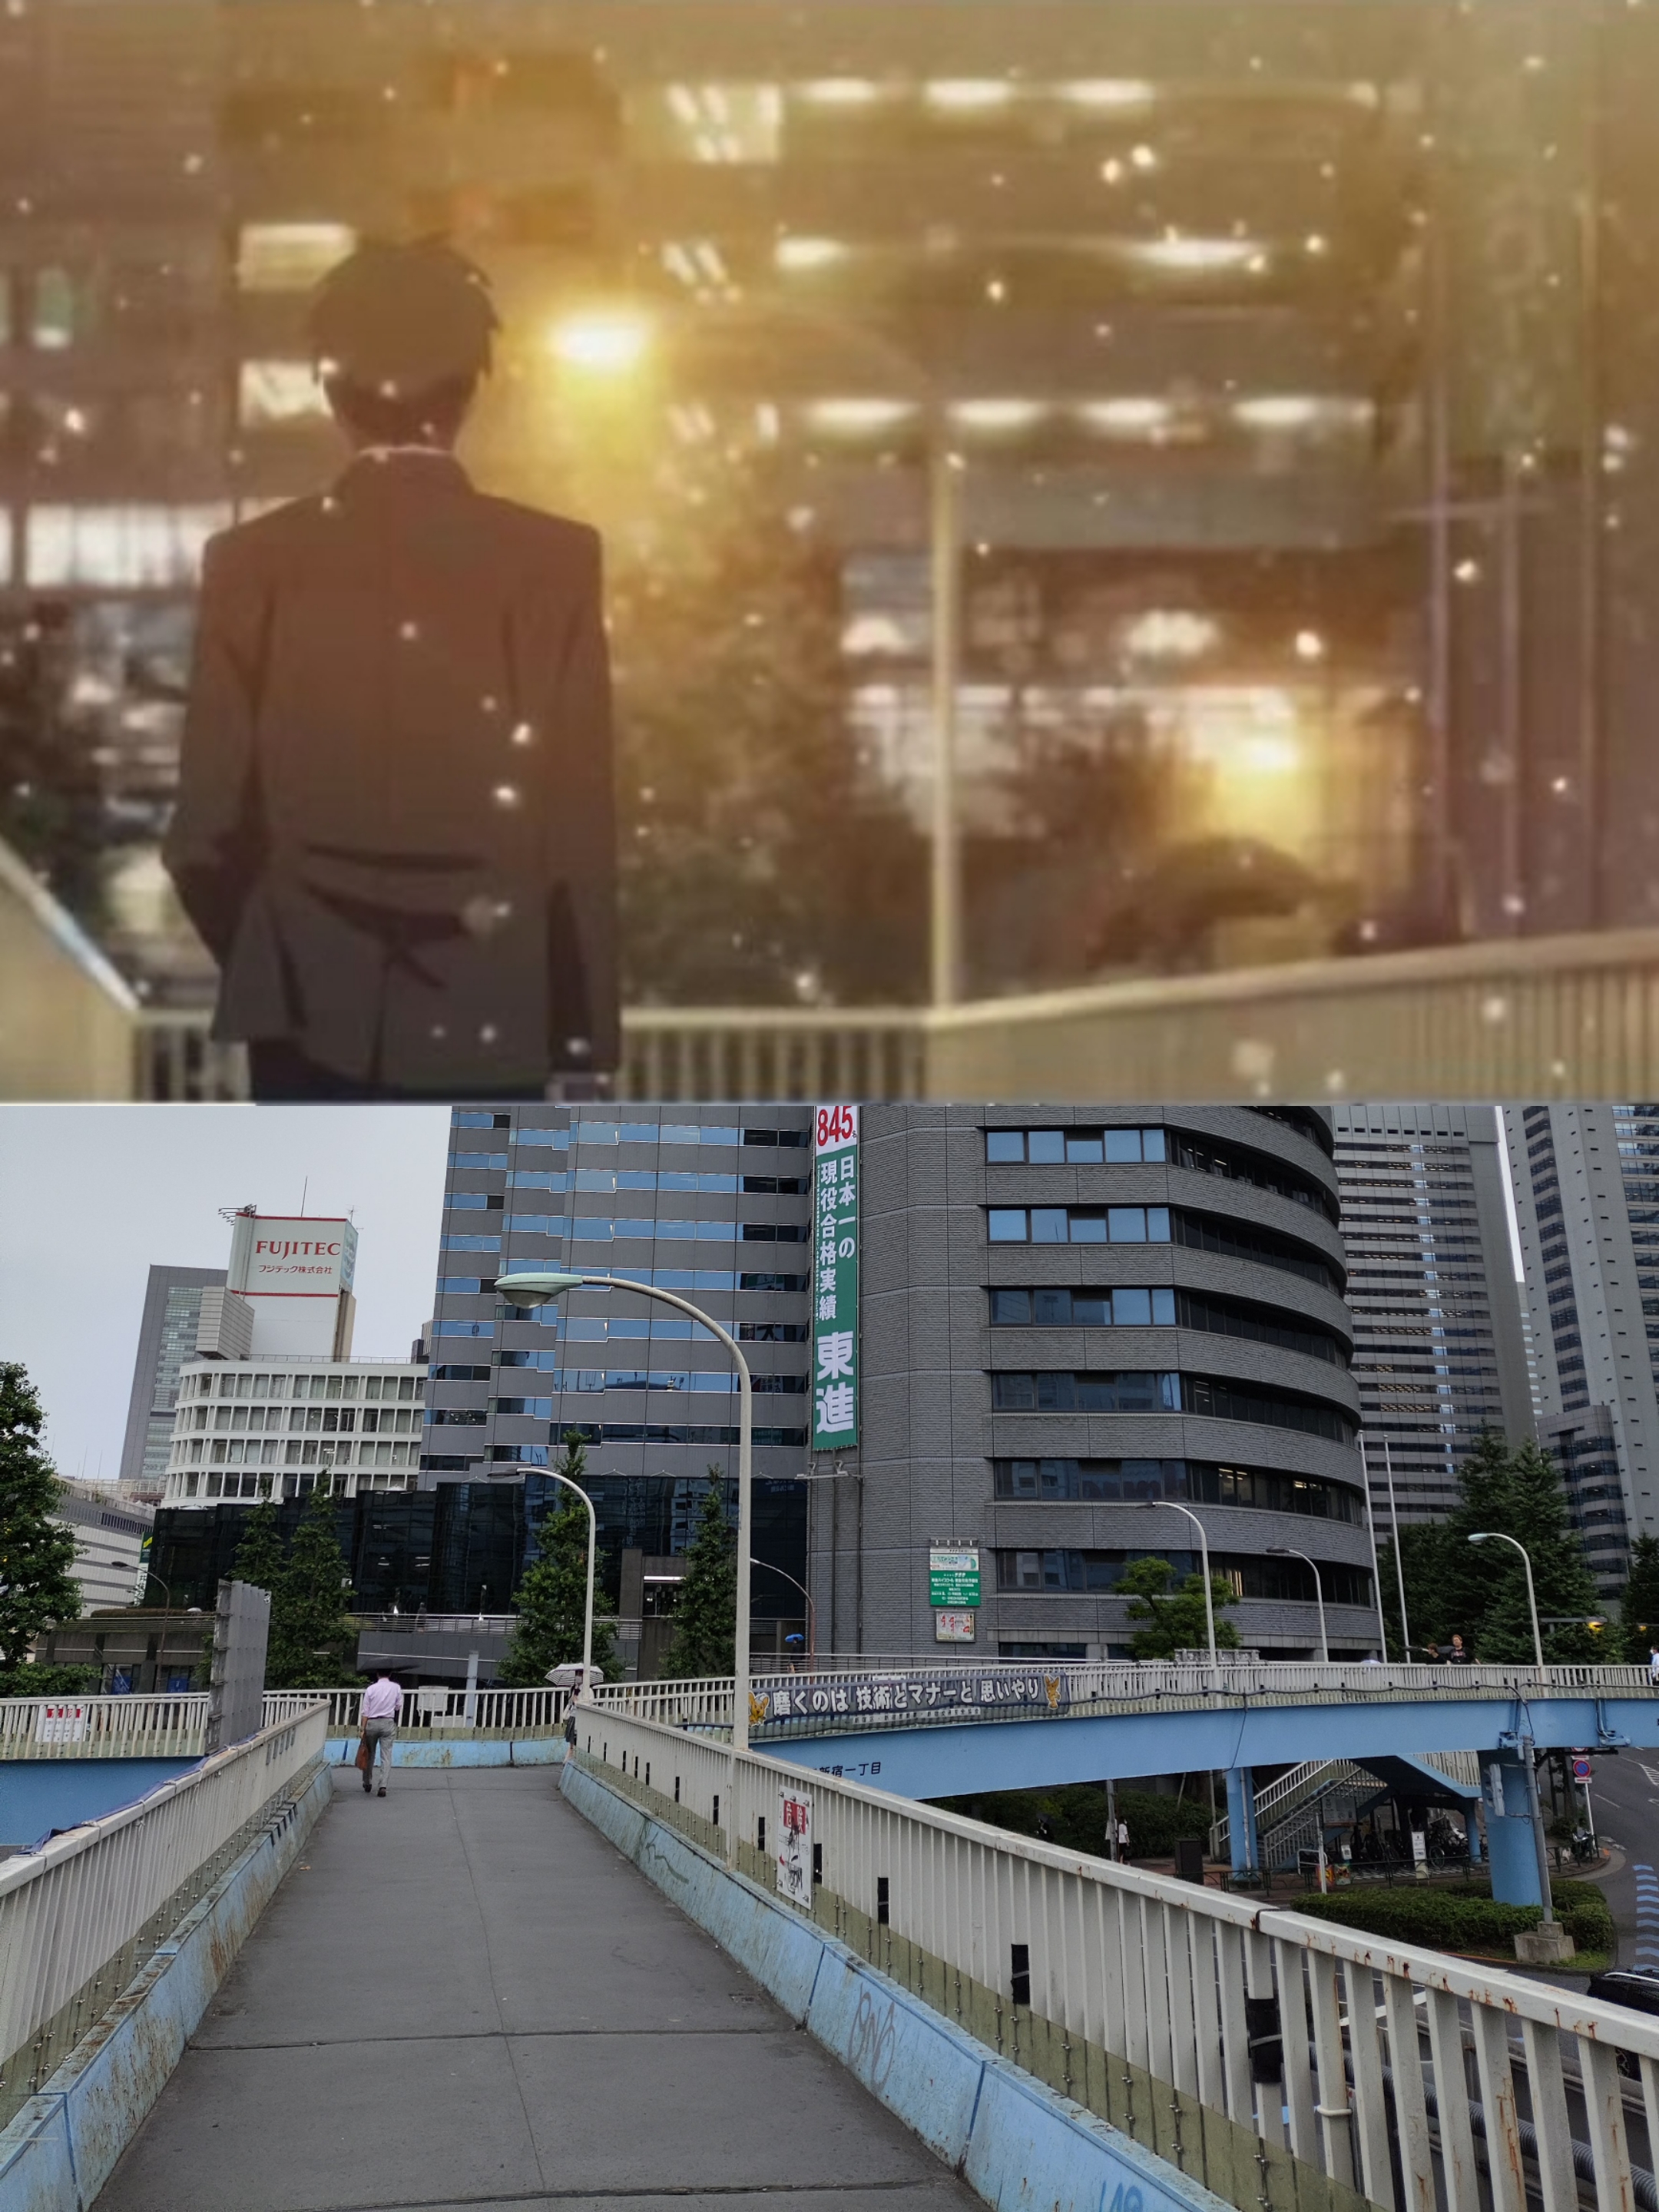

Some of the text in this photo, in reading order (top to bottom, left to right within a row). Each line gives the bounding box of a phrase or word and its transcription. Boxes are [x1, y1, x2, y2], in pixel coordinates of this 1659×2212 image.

[838, 1154, 855, 1259] 日本一の
[255, 1240, 341, 1260] FUJITEC
[819, 1160, 838, 1320] 現役合格実績
[258, 1265, 333, 1274] フジテック株式会社
[816, 1331, 854, 1434] 東進
[773, 1678, 1038, 1717] 磨くのは 技術とマナーと 思いやり
[813, 1761, 881, 1777] 新宿一丁目
